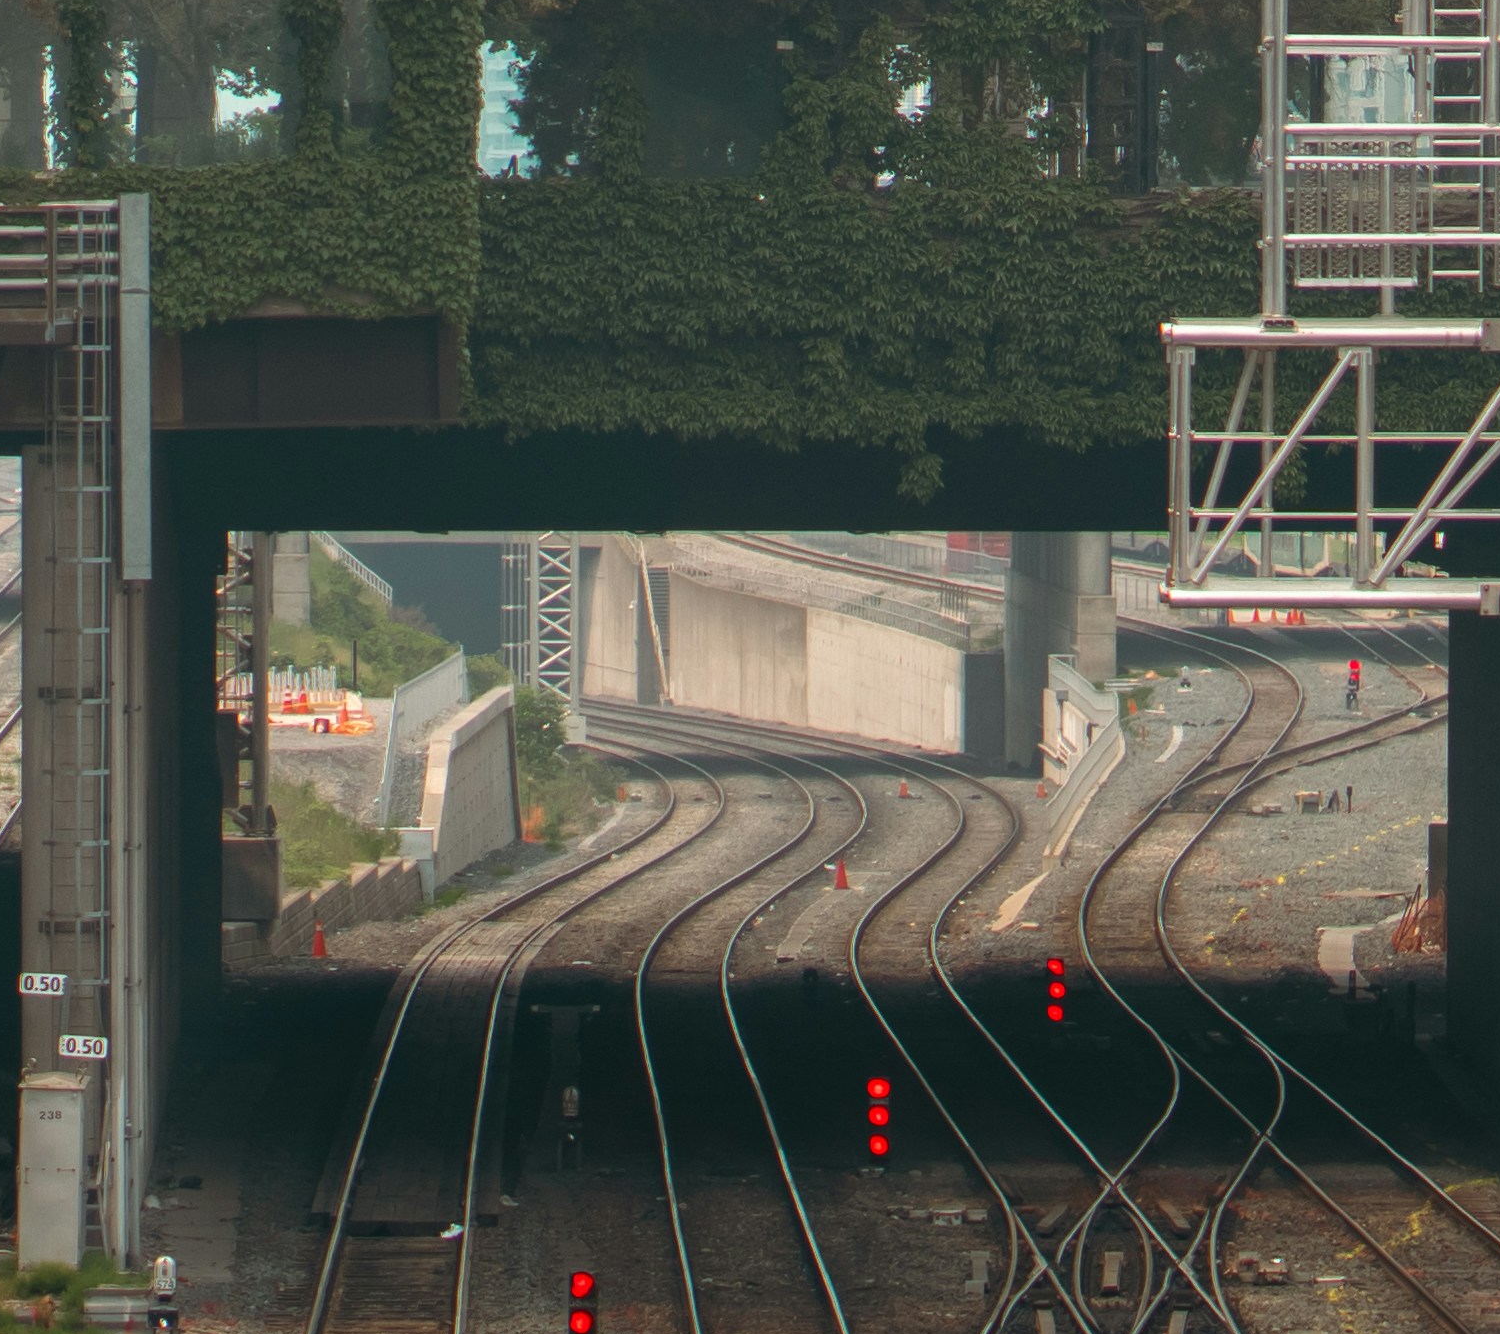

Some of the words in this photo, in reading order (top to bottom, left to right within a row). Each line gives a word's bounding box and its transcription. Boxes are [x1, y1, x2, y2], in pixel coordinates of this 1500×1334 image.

[23, 975, 61, 992] 0.50
[65, 1037, 103, 1055] 0.50
[39, 1110, 62, 1120] 238
